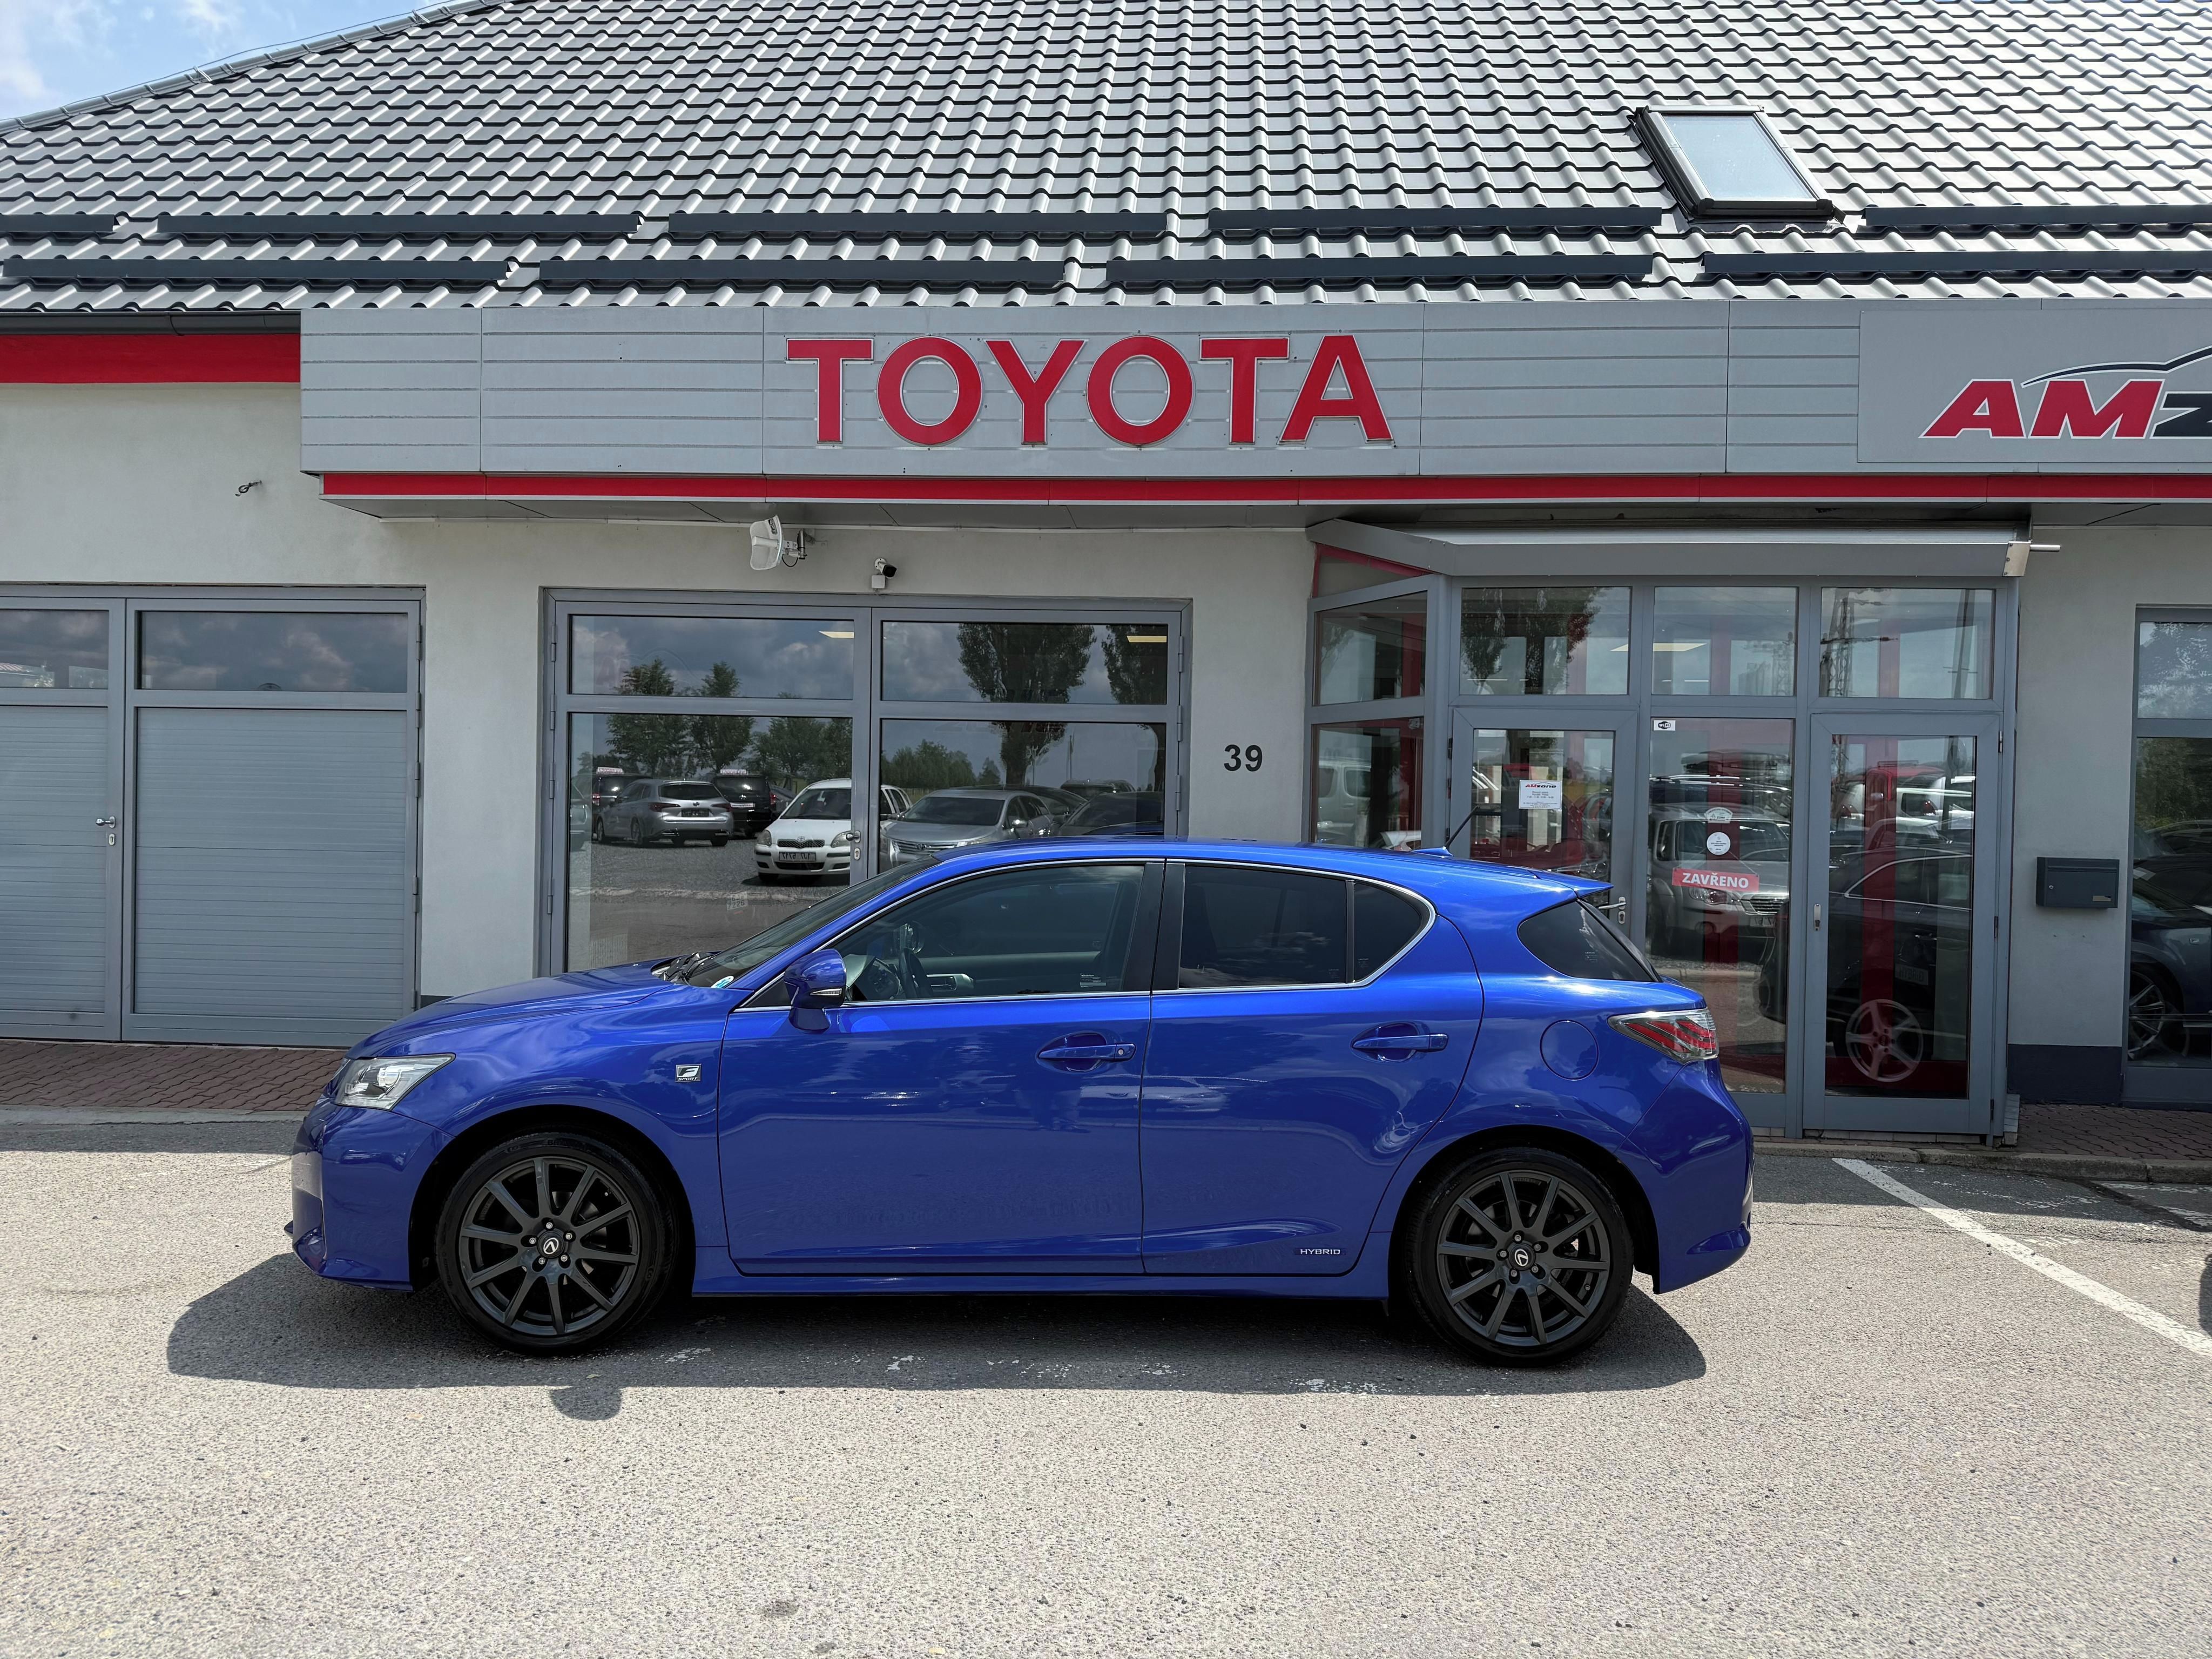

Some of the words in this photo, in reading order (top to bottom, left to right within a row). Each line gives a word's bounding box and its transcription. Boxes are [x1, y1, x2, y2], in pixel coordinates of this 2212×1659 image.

[785, 334, 1394, 447] TOYOTA
[1224, 744, 1263, 772] 39
[1682, 872, 1749, 888] ZAVŘENO
